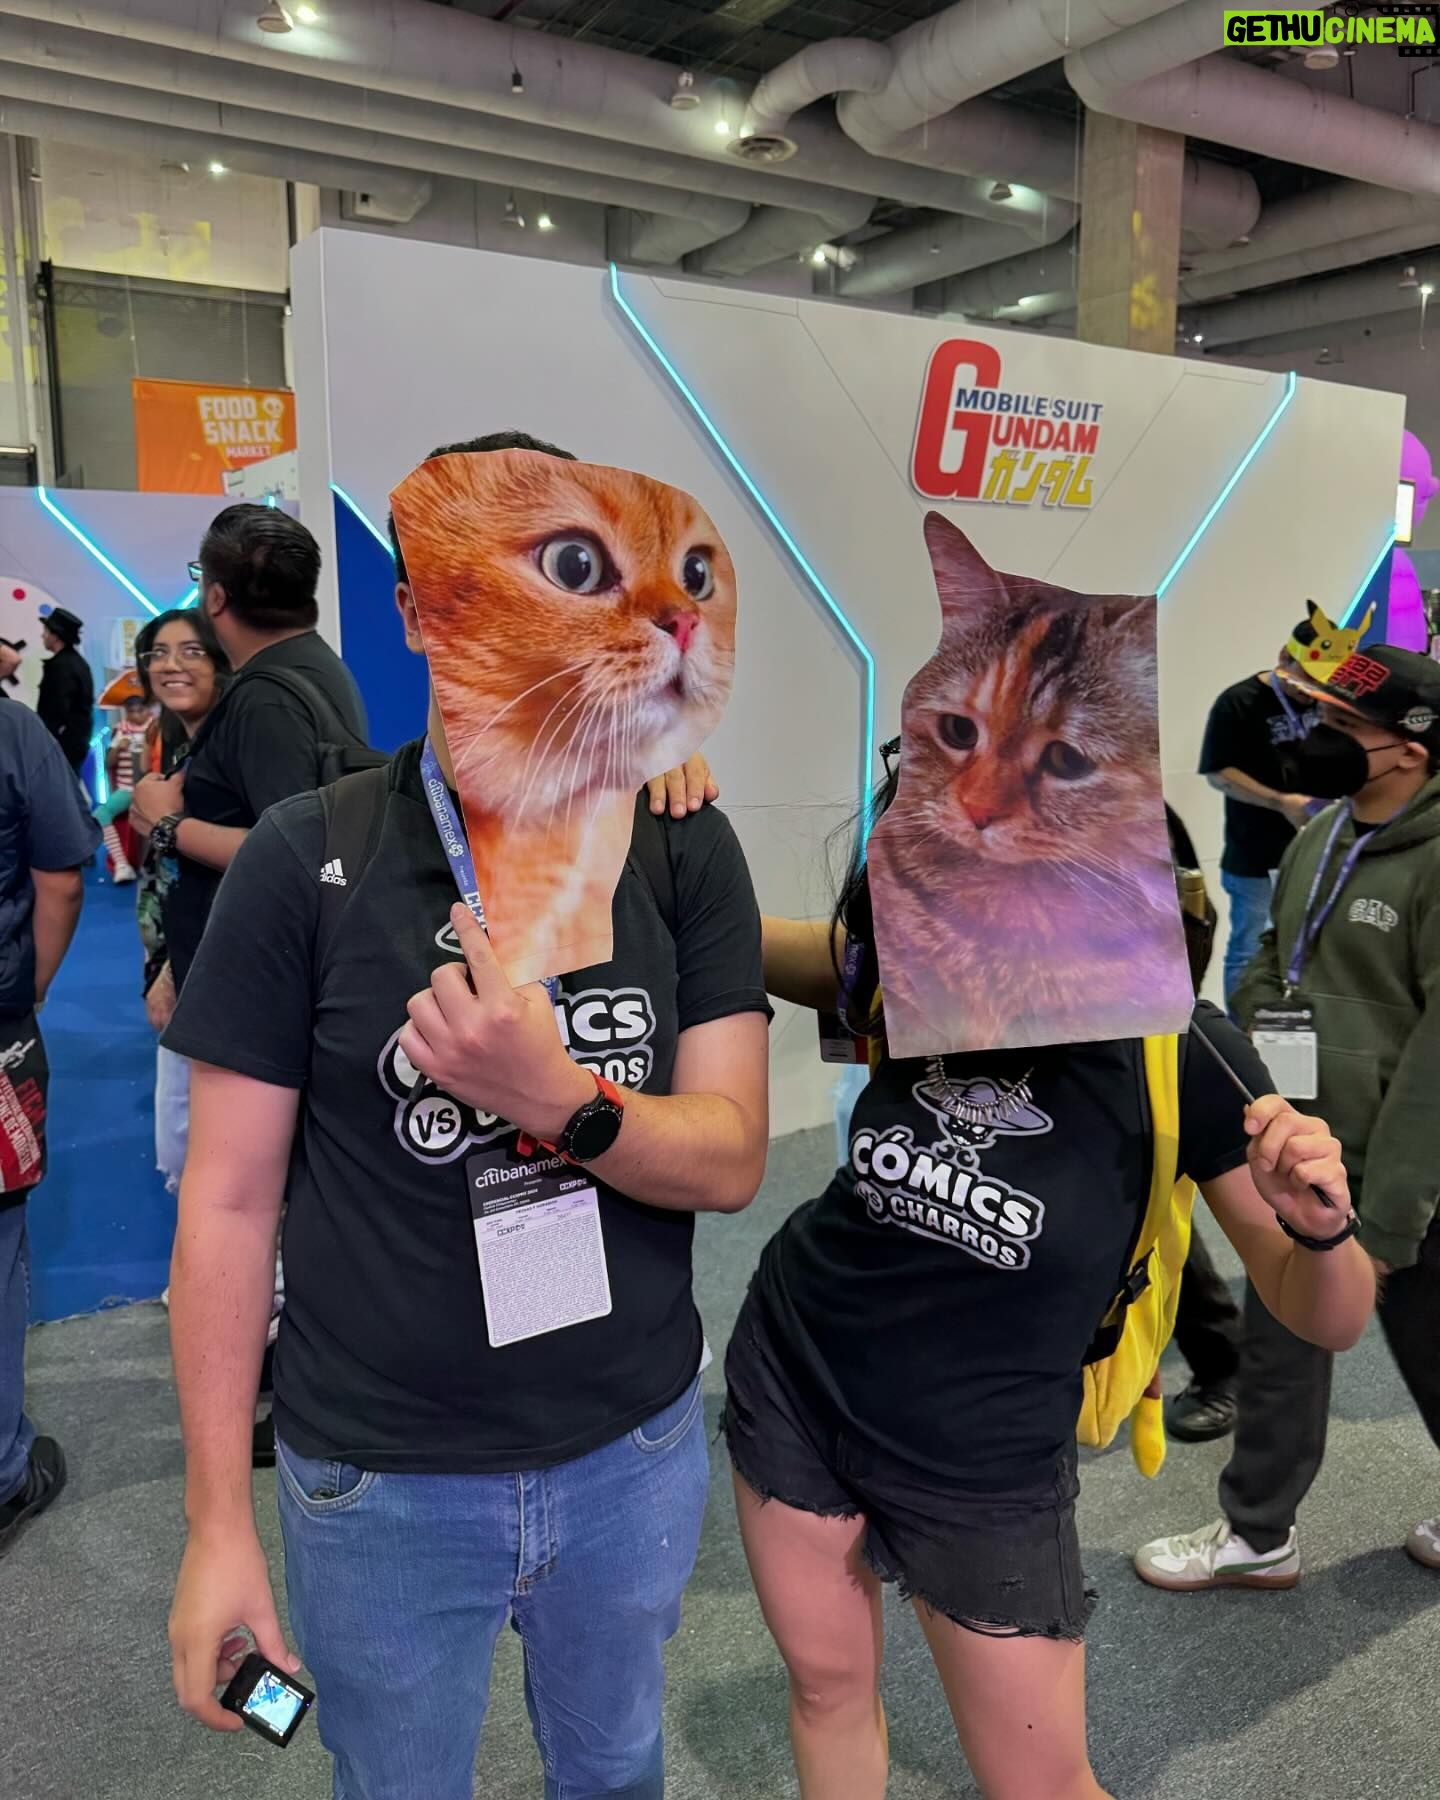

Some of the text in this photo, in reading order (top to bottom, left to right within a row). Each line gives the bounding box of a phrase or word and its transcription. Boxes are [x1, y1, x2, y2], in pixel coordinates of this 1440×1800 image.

[197, 396, 257, 420] FOOD
[956, 388, 1103, 422] MOBILE SUIT
[204, 419, 283, 445] SNACK
[225, 445, 271, 458] MARKET
[982, 449, 1094, 504] ガンダム
[428, 777, 457, 846] citibanamex
[415, 1107, 456, 1144] VS
[475, 1156, 568, 1188] citibanamex
[852, 1132, 1032, 1236] CÓMICS
[890, 1196, 1018, 1266] CHARROS
